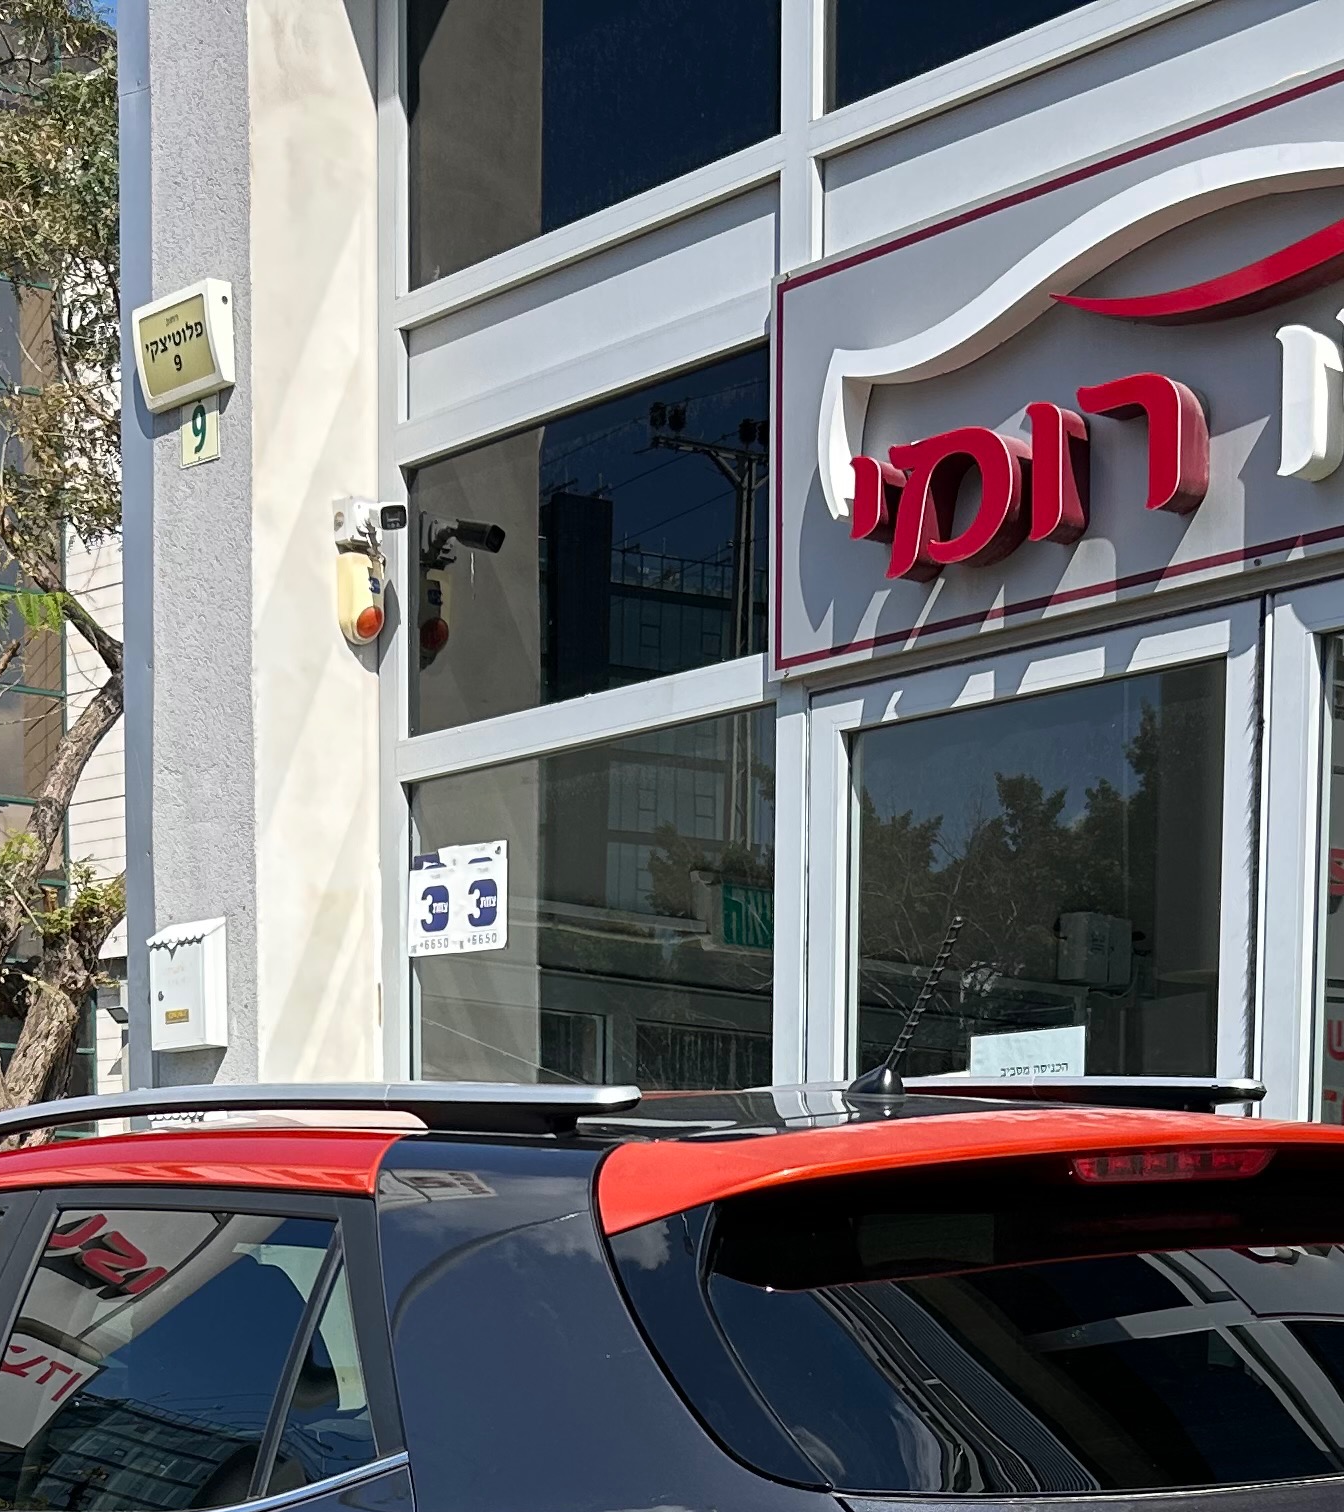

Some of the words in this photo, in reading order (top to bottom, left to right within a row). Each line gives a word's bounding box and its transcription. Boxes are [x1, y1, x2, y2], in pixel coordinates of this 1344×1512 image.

[145, 320, 204, 363] פלוטיצקי
[174, 354, 183, 371] 9
[191, 404, 207, 454] 9
[849, 372, 1211, 584] רומי
[1033, 1062, 1069, 1075] הכניסה
